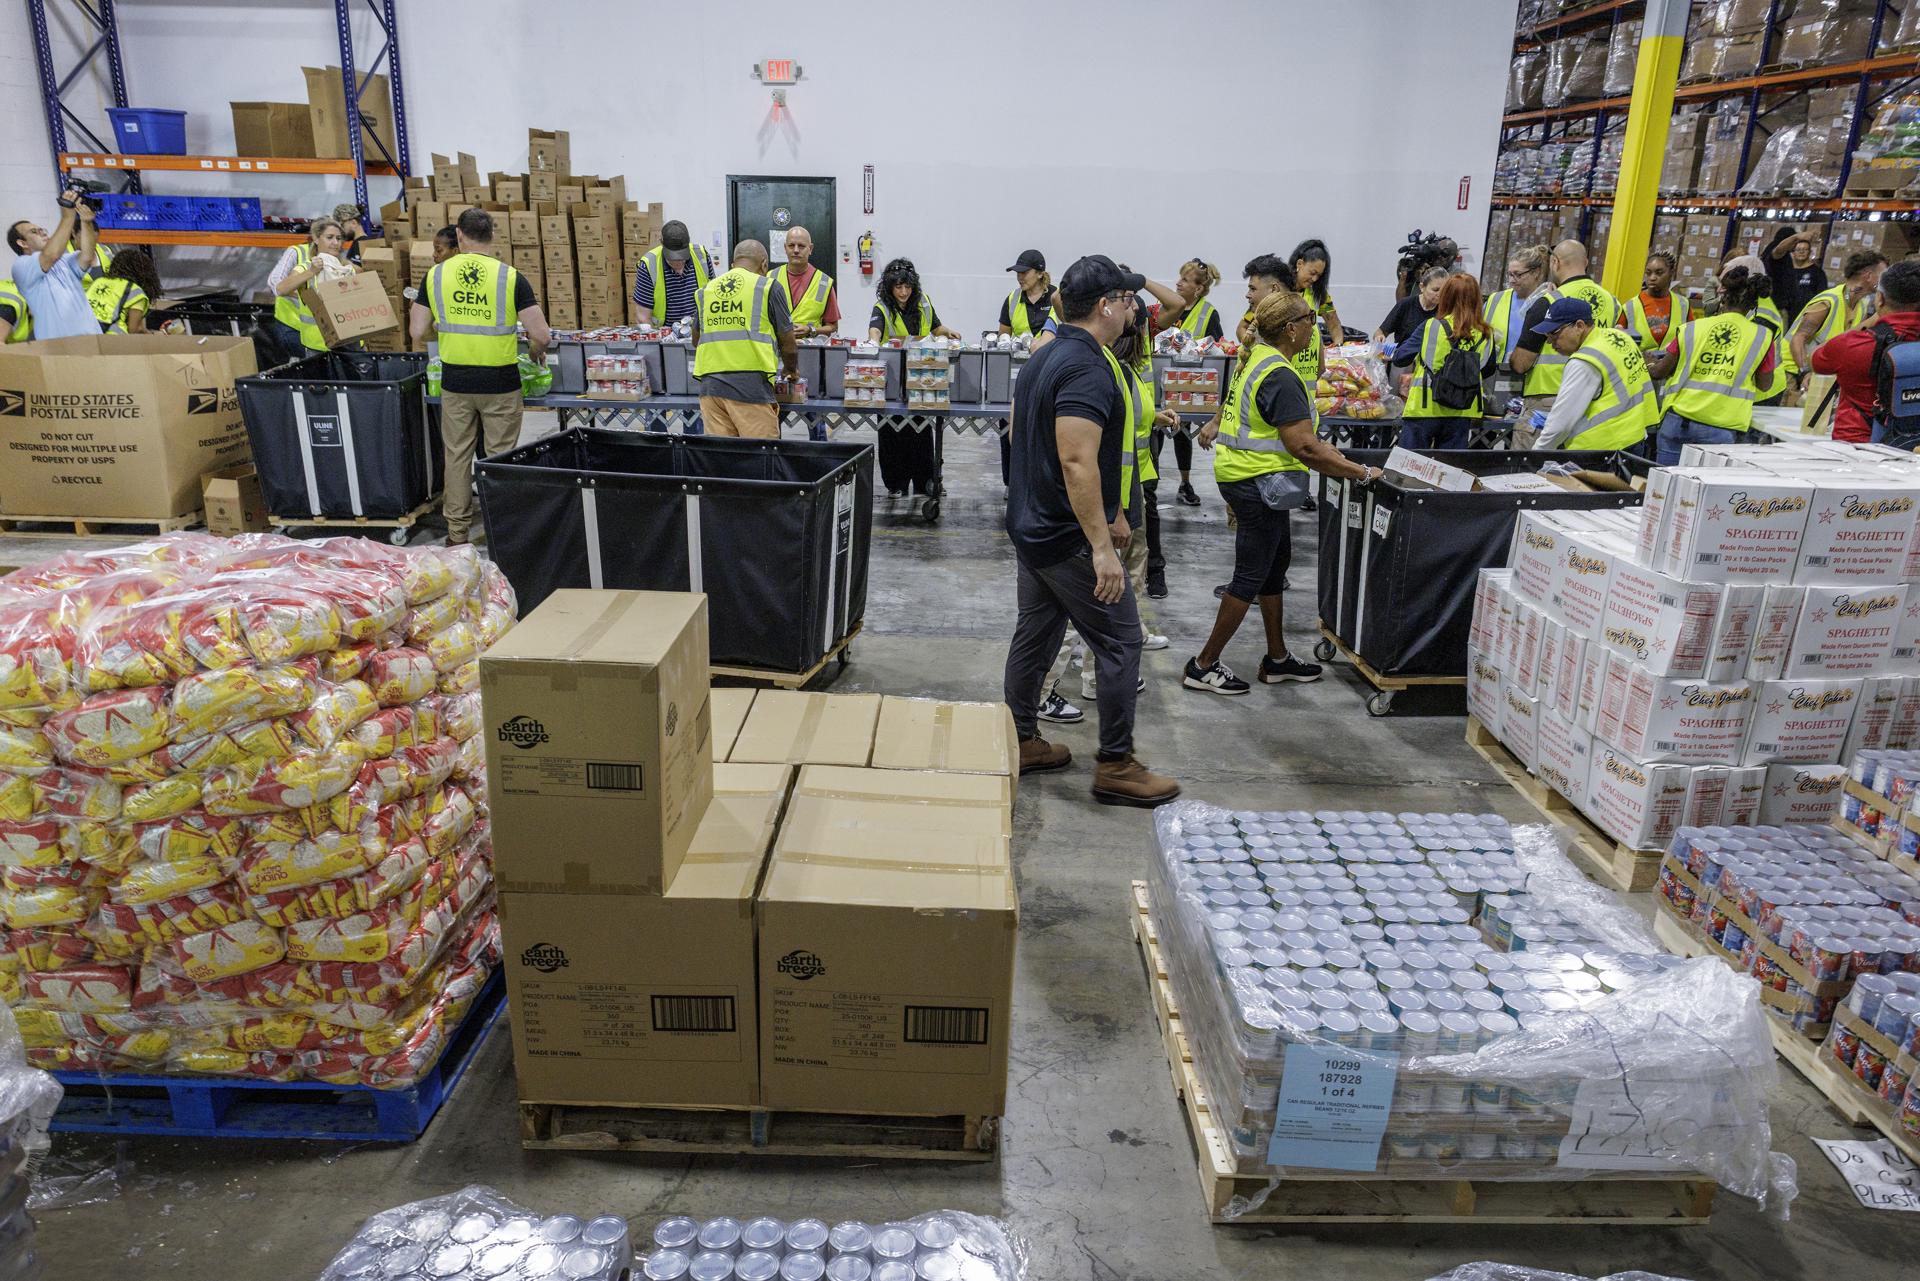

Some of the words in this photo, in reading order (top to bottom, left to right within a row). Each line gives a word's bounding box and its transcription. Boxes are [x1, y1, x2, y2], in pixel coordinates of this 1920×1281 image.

[768, 60, 791, 80] EXIT
[453, 290, 488, 305] GEM
[450, 306, 492, 320] bstrong
[710, 300, 742, 313] GEM
[334, 304, 388, 324] bstrong
[707, 316, 746, 326] bstrong
[1298, 349, 1318, 362] GEM
[1700, 352, 1735, 366] GEM
[1694, 366, 1734, 380] bstrong
[30, 394, 82, 405] UNITED
[84, 394, 134, 405] STATES
[30, 408, 78, 419] POSTAL
[54, 433, 73, 441] NOT
[199, 437, 229, 447] DESIGNED
[10, 443, 50, 452] DESIGNED
[52, 444, 70, 452] FOR
[71, 444, 117, 453] MULTIPLE
[32, 455, 75, 464] PROPERTY
[61, 476, 102, 484] RECYCLE
[1734, 502, 1765, 518] Chef
[1766, 498, 1804, 517] John's
[1845, 504, 1874, 520] Chef
[1875, 499, 1913, 520] John's
[1726, 528, 1798, 540] SPAGHETTI
[1836, 531, 1905, 540] SPAGHETTI
[1522, 553, 1551, 575] SPAGHETTI
[1569, 556, 1584, 574] Chef
[1584, 557, 1607, 574] John's
[1565, 577, 1602, 600] SPAGHETTI
[1836, 602, 1862, 617] Chef
[1864, 596, 1897, 615] John's
[1609, 601, 1654, 627] SPAGHETTI
[1606, 628, 1626, 646] John's
[1627, 632, 1645, 649] Chef
[1827, 627, 1890, 638] SPAGHETTI
[1687, 693, 1716, 709] Chef
[1717, 688, 1752, 708] John's
[1793, 696, 1819, 710] Chef
[1821, 688, 1853, 709] John's
[502, 720, 544, 733] earth
[1680, 718, 1744, 728] SPAGHETTI
[1784, 719, 1846, 730] SPAGHETTI
[498, 728, 550, 743] breeze
[1541, 741, 1571, 768] SPAGHETTI
[1606, 760, 1622, 778] Chef
[1622, 768, 1647, 788] John's
[1798, 779, 1825, 794] Chef
[1600, 780, 1642, 812] SPAGHETTI
[525, 947, 564, 958] earth
[521, 953, 569, 967] breeze
[782, 954, 822, 966] earth
[190, 969, 215, 980] QUICK
[777, 960, 825, 976] breeze
[1838, 1034, 1849, 1050] Ripe
[1324, 1060, 1360, 1070] 10299
[1858, 1050, 1872, 1068] Ripe
[1319, 1073, 1362, 1085] 187928
[1884, 1070, 1898, 1088] Ripe
[1321, 1086, 1327, 1095] 1
[1332, 1088, 1345, 1096] of
[1348, 1089, 1355, 1097] 4
[1326, 1101, 1360, 1109] TRADITIONAL
[1827, 1145, 1864, 1164] Do
